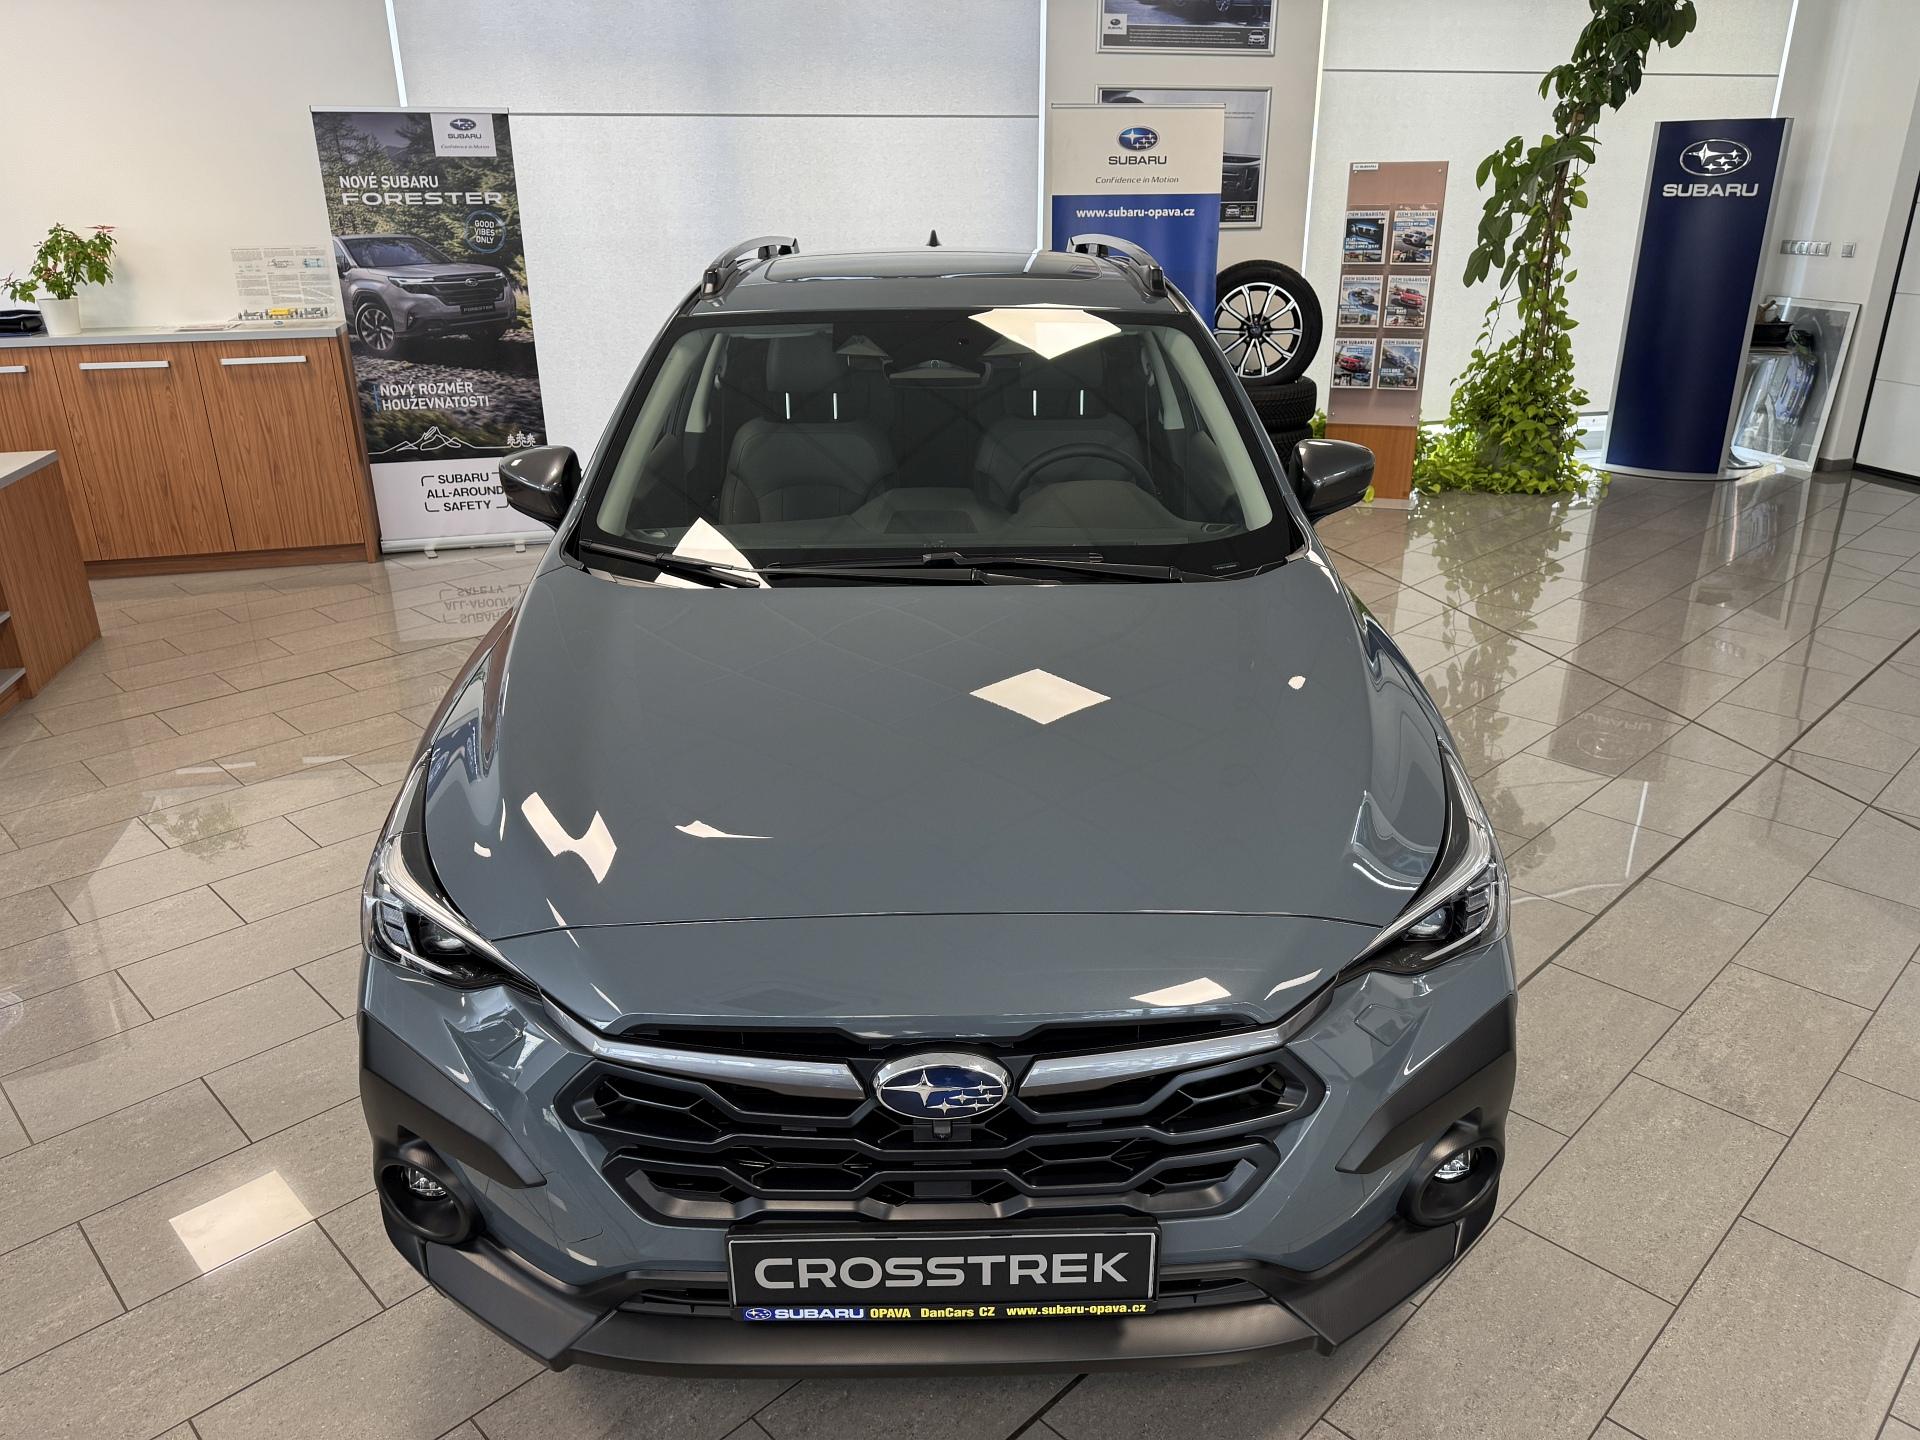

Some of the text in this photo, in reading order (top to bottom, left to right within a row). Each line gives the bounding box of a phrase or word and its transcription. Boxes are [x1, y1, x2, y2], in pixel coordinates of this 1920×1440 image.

[1108, 155, 1167, 165] SUBARU
[339, 172, 439, 188] NOVÉ SUBARU
[1095, 176, 1179, 184] Confidence in Motion
[1662, 183, 1759, 197] SUBARU
[342, 191, 502, 206] FORESTER
[1076, 206, 1195, 219] www.subaru-opava.cz
[474, 220, 495, 229] GOOD
[474, 228, 495, 237] VIBES
[476, 236, 494, 244] ONLY
[380, 379, 474, 397] NOVÝ ROZMĚR
[382, 395, 490, 411] HOUŽEVNATOSTI
[437, 473, 489, 484] SUBARU
[427, 485, 505, 498] ALL-AROUND
[443, 500, 491, 512] SAFETY
[754, 1252, 1129, 1289] CROSSTREK
[774, 1302, 1147, 1319] SUBARU OPAVA DanCars CZ www.subaru-opava.cz
